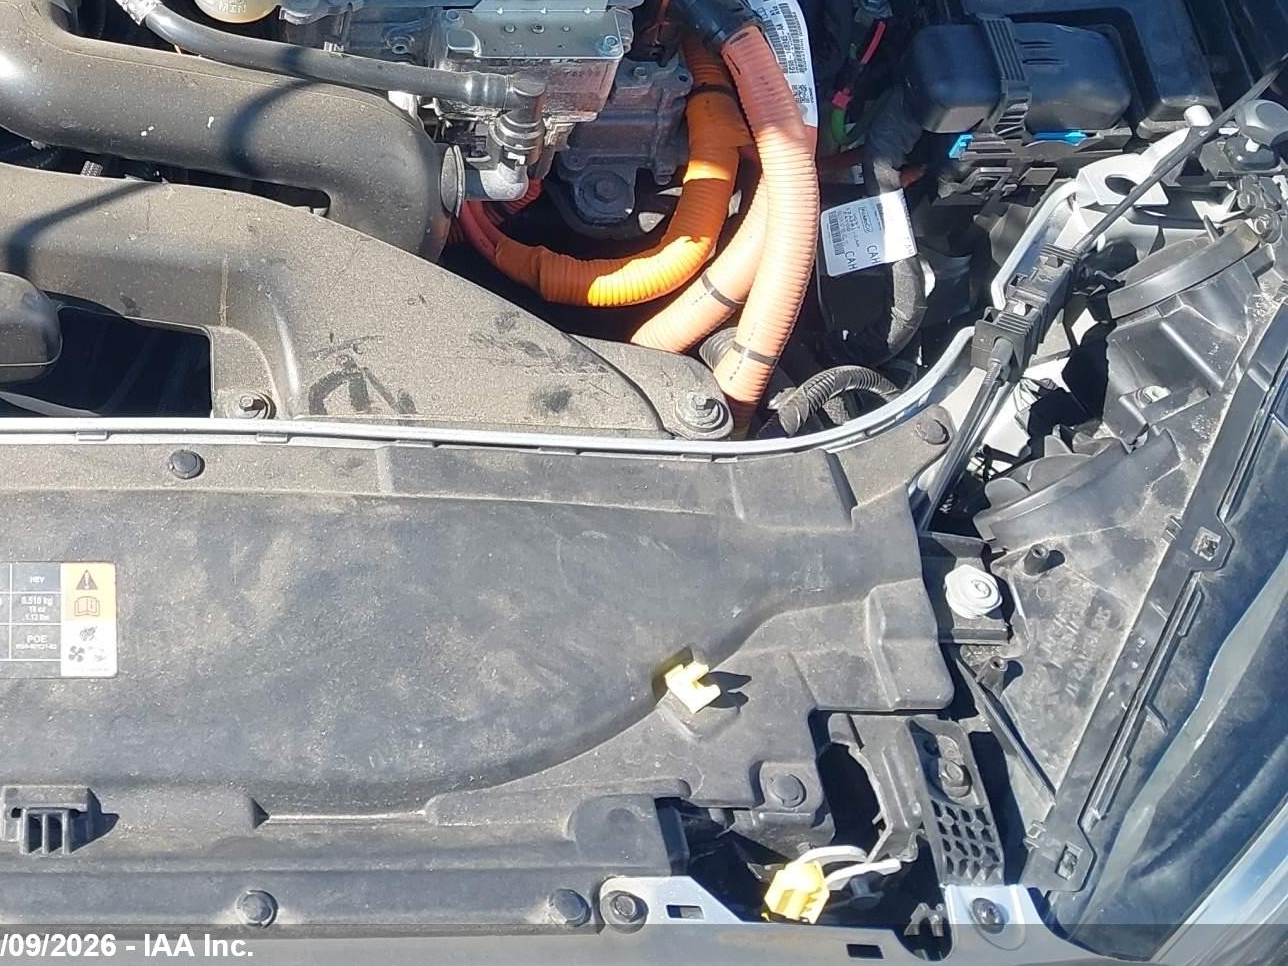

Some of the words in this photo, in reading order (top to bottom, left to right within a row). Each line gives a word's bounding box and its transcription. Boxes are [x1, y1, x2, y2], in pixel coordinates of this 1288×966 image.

[845, 250, 858, 270] CAH
[866, 244, 881, 264] CAH
[42, 596, 54, 606] kg
[26, 635, 48, 643] POE
